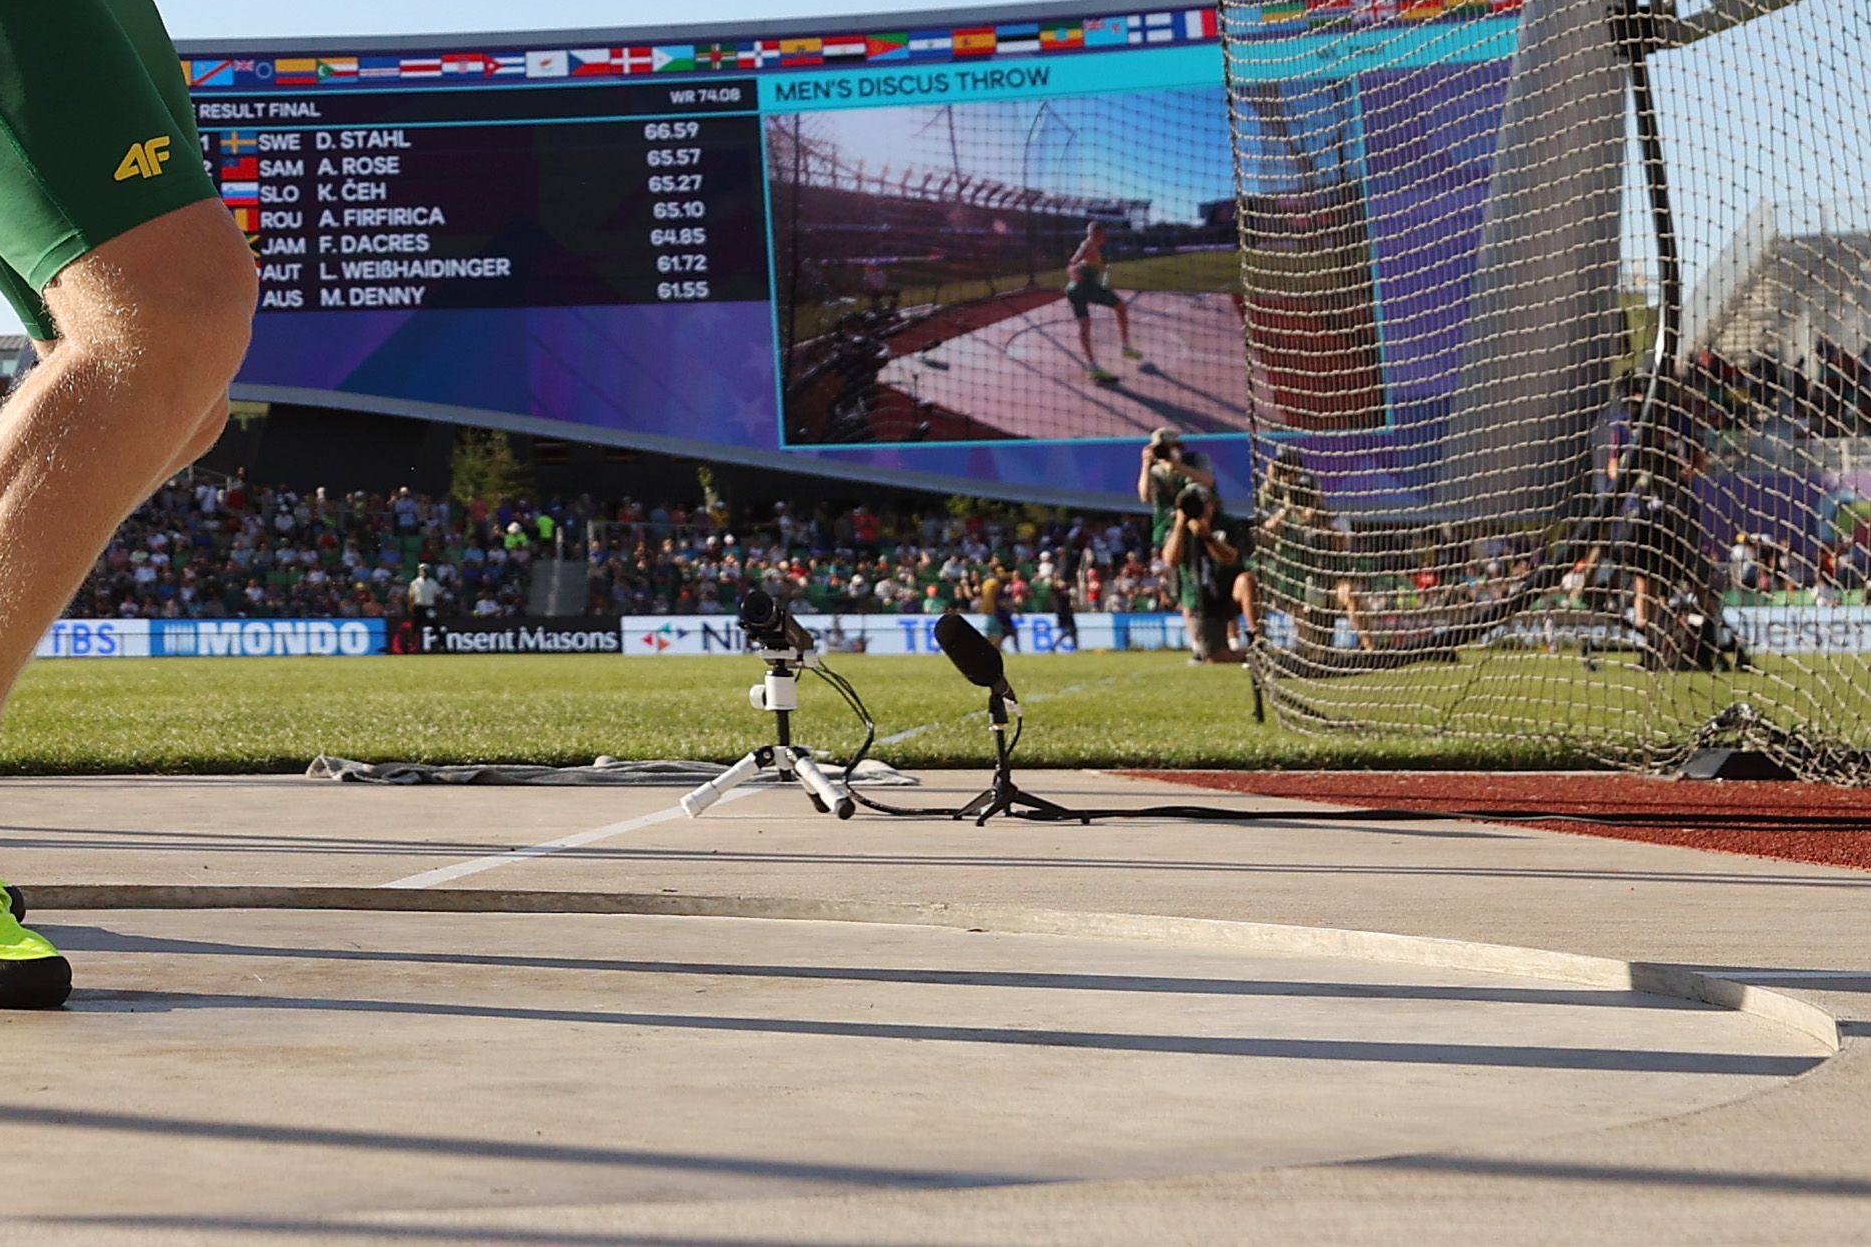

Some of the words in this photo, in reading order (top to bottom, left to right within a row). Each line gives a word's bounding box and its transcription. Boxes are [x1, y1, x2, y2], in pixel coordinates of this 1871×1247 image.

[670, 91, 695, 103] WR
[697, 88, 741, 102] 74.08
[775, 79, 852, 102] MEN'S
[858, 73, 949, 98] DISCUS
[954, 67, 1051, 91] THROW
[200, 102, 265, 119] RESULT
[269, 102, 321, 118] FINAL
[259, 134, 300, 151] SWE
[316, 132, 336, 149] D.
[340, 130, 411, 149] STAHL
[644, 122, 699, 140] 66.59
[114, 135, 170, 181] 4F
[260, 160, 303, 176] SAM
[318, 158, 338, 175] A.
[342, 156, 400, 174] ROSE
[647, 148, 701, 166] 65.57
[260, 186, 299, 203] SLO
[318, 184, 337, 201] K.
[342, 179, 387, 200] ČEH
[648, 175, 702, 192] 65.27
[261, 212, 302, 229] ROU
[319, 210, 339, 227] A.
[344, 207, 445, 226] FIRFIRICA
[653, 201, 705, 219] 65.10
[261, 238, 306, 255] JAM
[319, 236, 337, 253] F.
[341, 234, 429, 252] DACRES
[650, 228, 706, 245] 64.85
[262, 264, 302, 280] AUT
[320, 262, 338, 279] L.
[657, 255, 708, 272] 61.72
[263, 290, 303, 307] AUS
[321, 288, 345, 305] M.
[349, 286, 425, 305] DENNY
[657, 281, 709, 299] 61.55
[50, 623, 116, 654] TBS
[197, 622, 369, 655] MONDO
[518, 626, 619, 651] Masons
